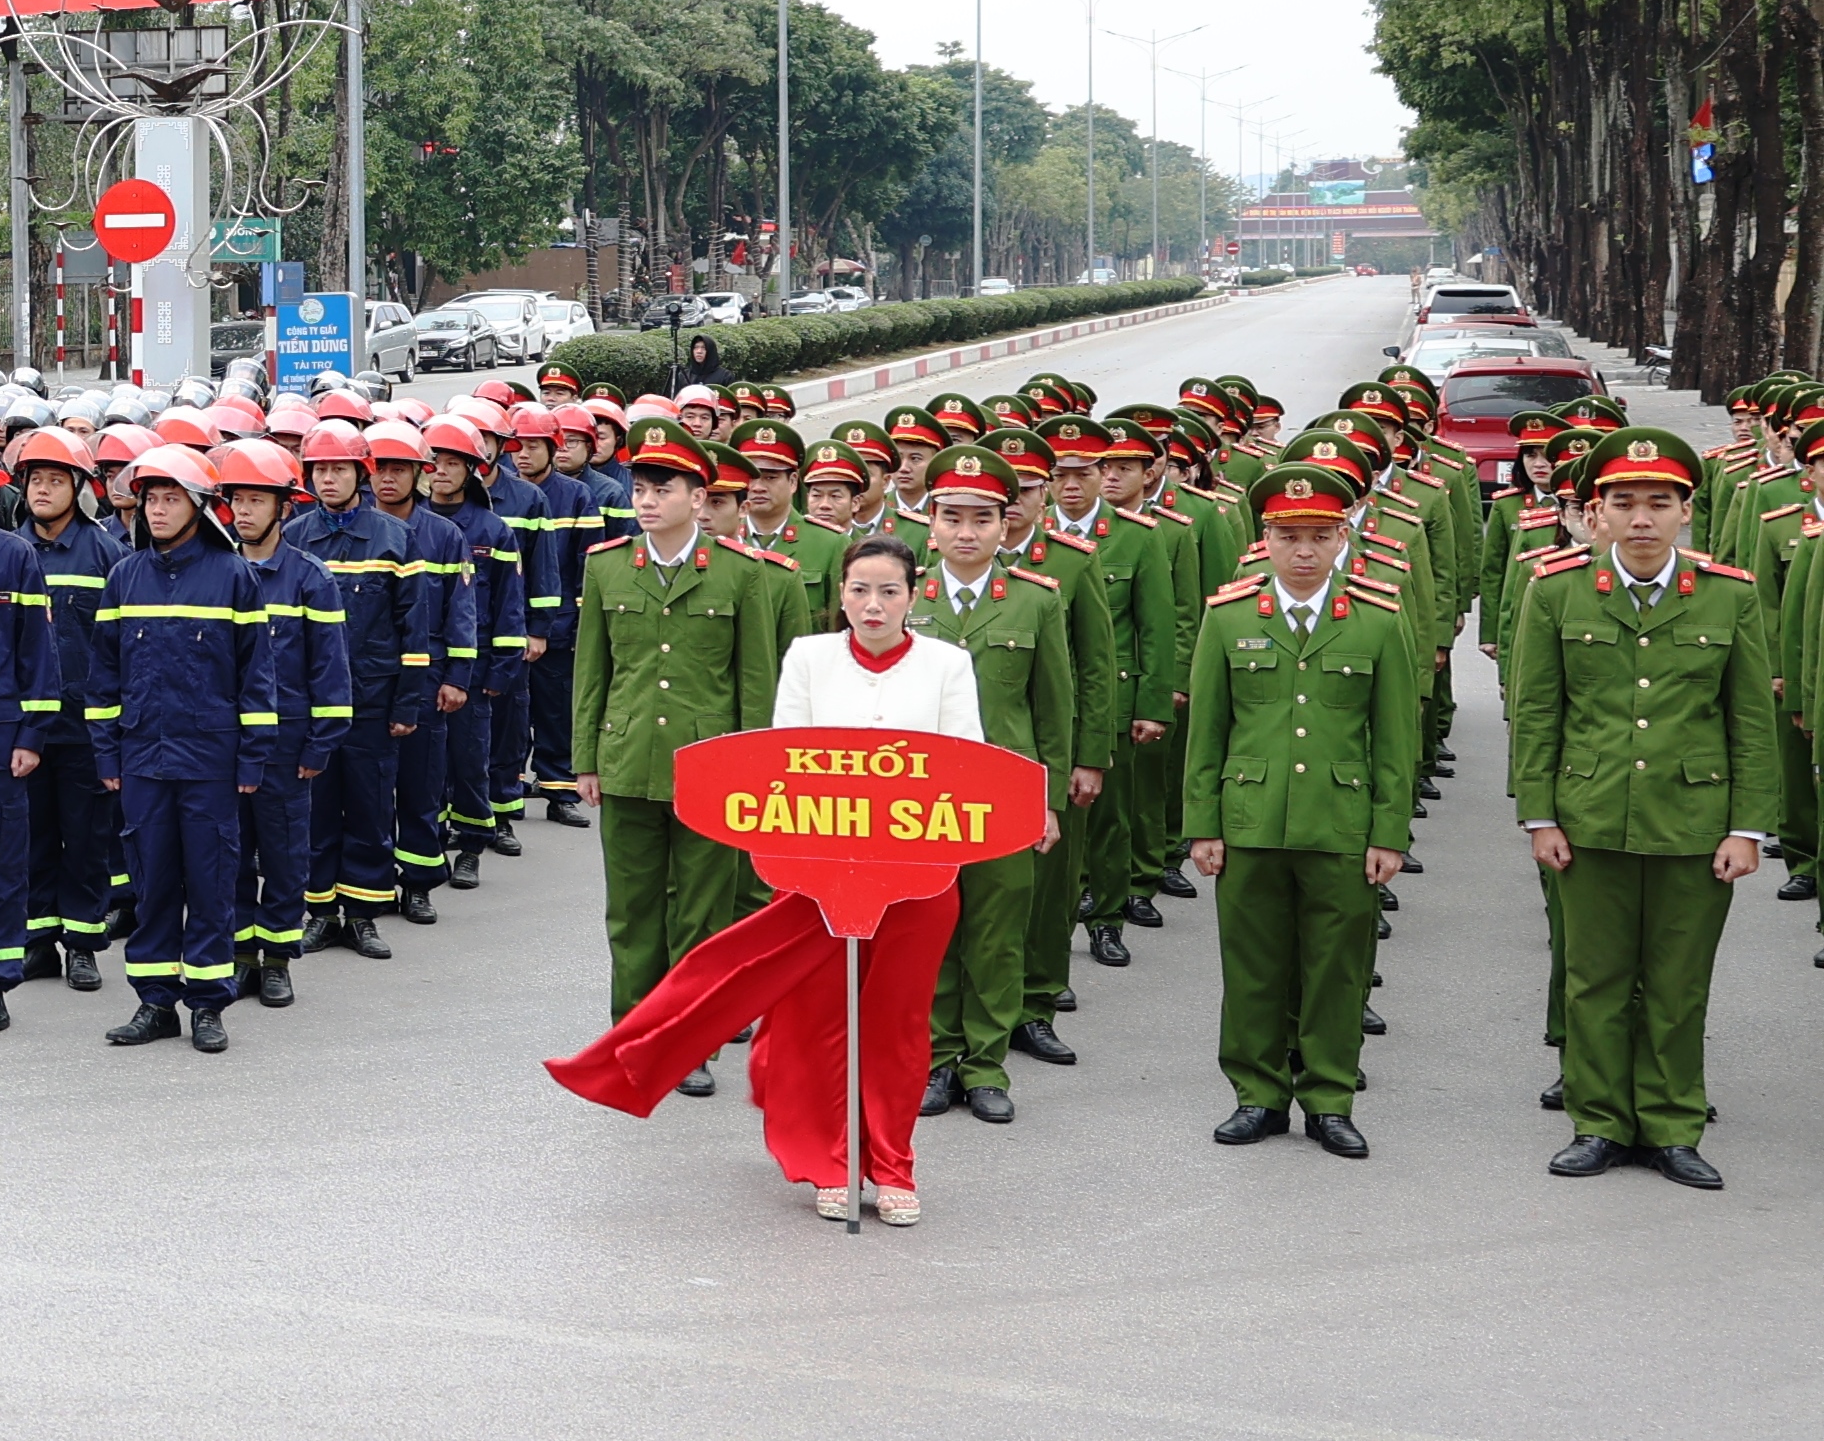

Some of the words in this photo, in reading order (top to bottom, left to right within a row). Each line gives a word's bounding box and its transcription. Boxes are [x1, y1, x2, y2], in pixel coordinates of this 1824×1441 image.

[286, 326, 308, 336] CÔNG
[309, 326, 318, 335] TY
[320, 323, 338, 335] GIẤY
[278, 336, 309, 354] TIẾN
[312, 336, 348, 353] DŨNG
[293, 360, 310, 370] TÀI
[312, 360, 333, 371] TRỢ
[785, 740, 929, 779] KHỐI
[725, 780, 870, 838] CẢNH
[889, 793, 992, 843] SÁT
